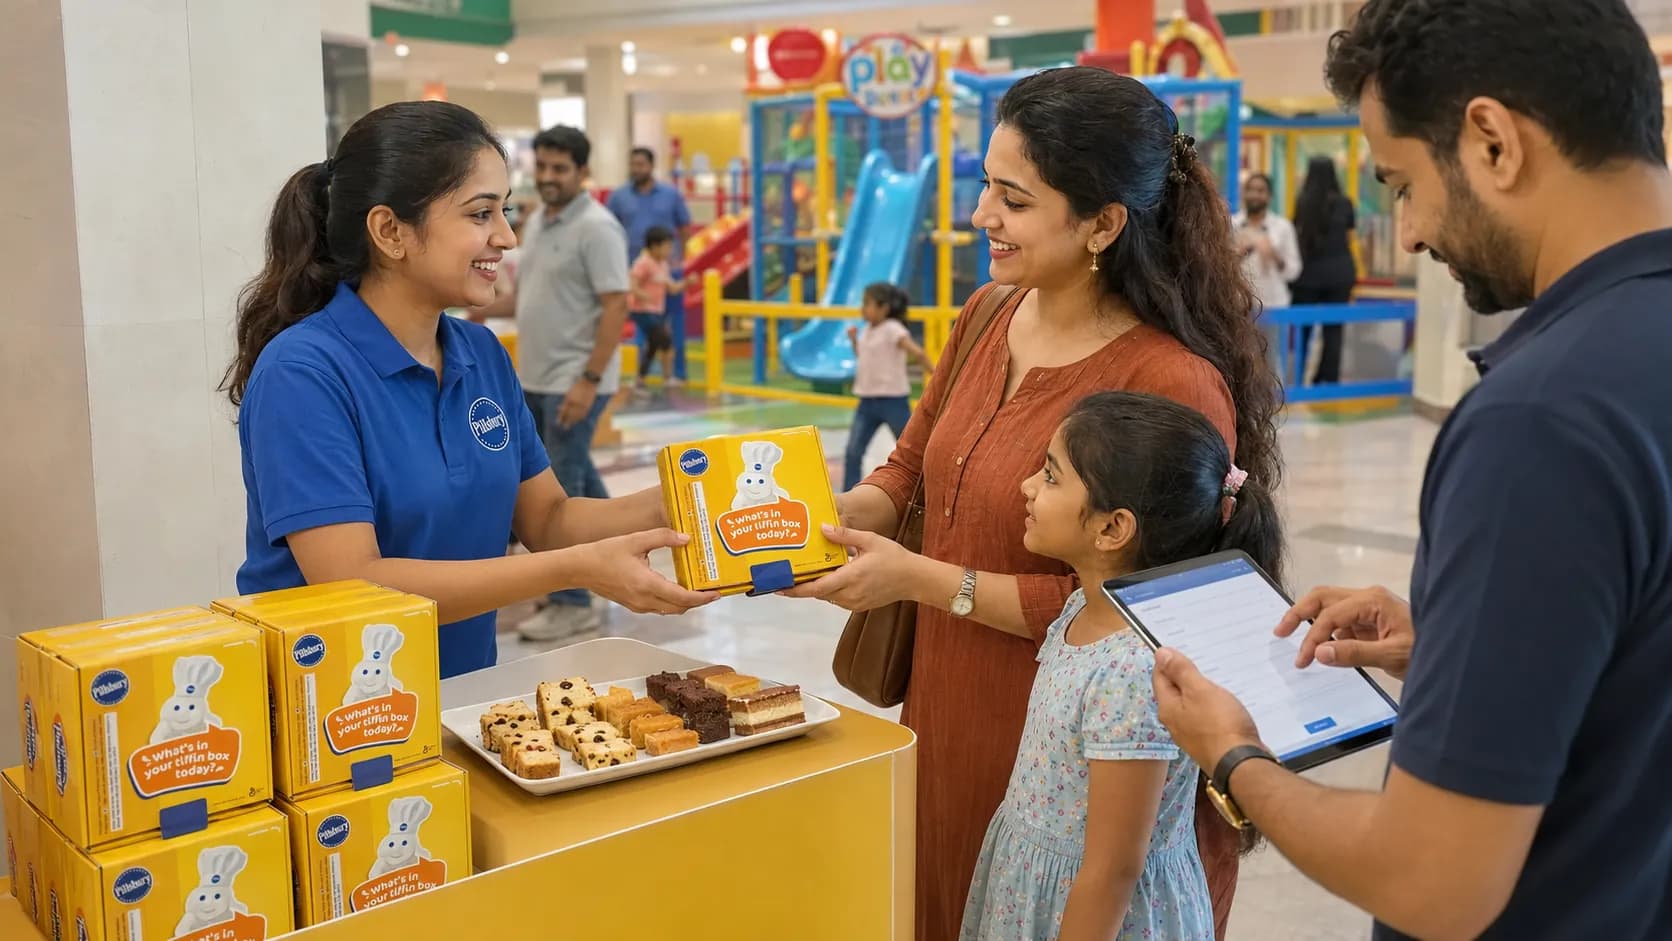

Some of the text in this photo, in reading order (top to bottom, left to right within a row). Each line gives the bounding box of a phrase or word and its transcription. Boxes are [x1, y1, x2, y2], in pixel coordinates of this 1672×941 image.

[851, 47, 931, 92] play
[472, 414, 505, 436] Pillsbury
[771, 509, 781, 518] in
[730, 519, 801, 539] your tiffin box
[756, 529, 790, 540] today?
[382, 703, 392, 712] in
[337, 713, 408, 738] your tiffin box
[363, 723, 397, 737] today?
[197, 740, 208, 751] in
[144, 751, 230, 780] your tiffin box
[175, 762, 217, 778] today?
[408, 872, 418, 882] in
[222, 928, 235, 939] in
